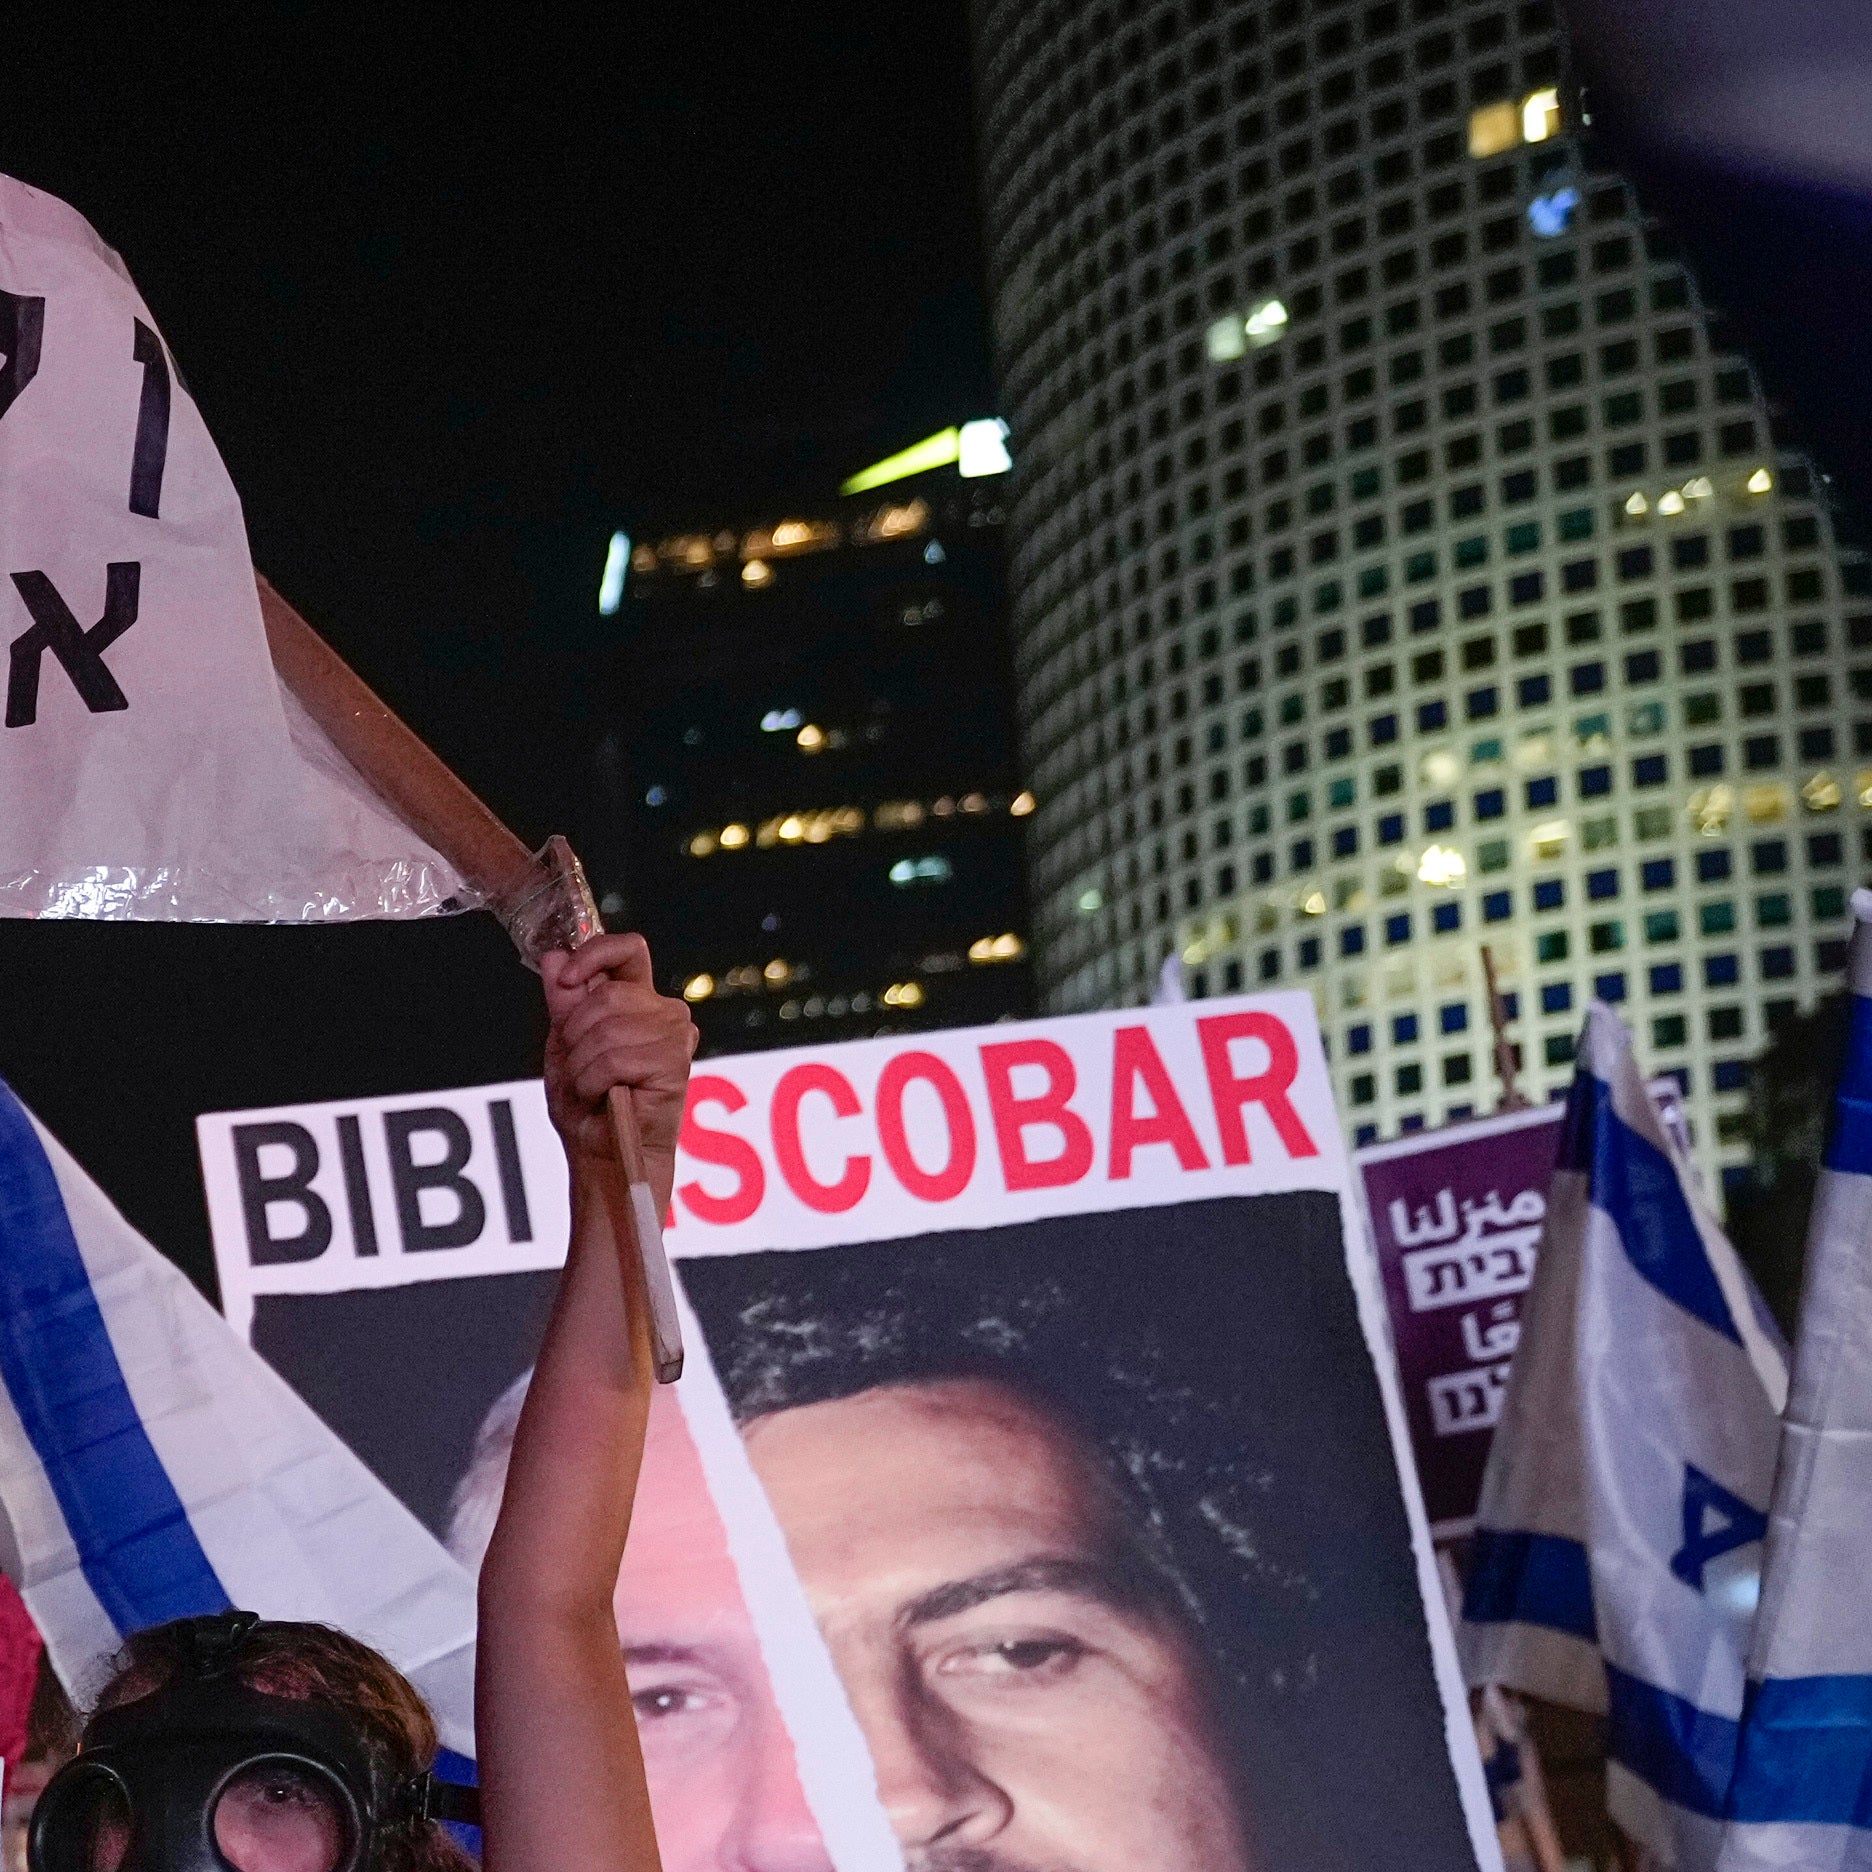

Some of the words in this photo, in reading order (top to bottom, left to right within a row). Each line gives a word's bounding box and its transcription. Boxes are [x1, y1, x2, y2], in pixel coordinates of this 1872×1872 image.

[232, 1099, 535, 1267] BIBI
[666, 1010, 1320, 1230] SCOBAR
[1424, 1247, 1529, 1297] בית
